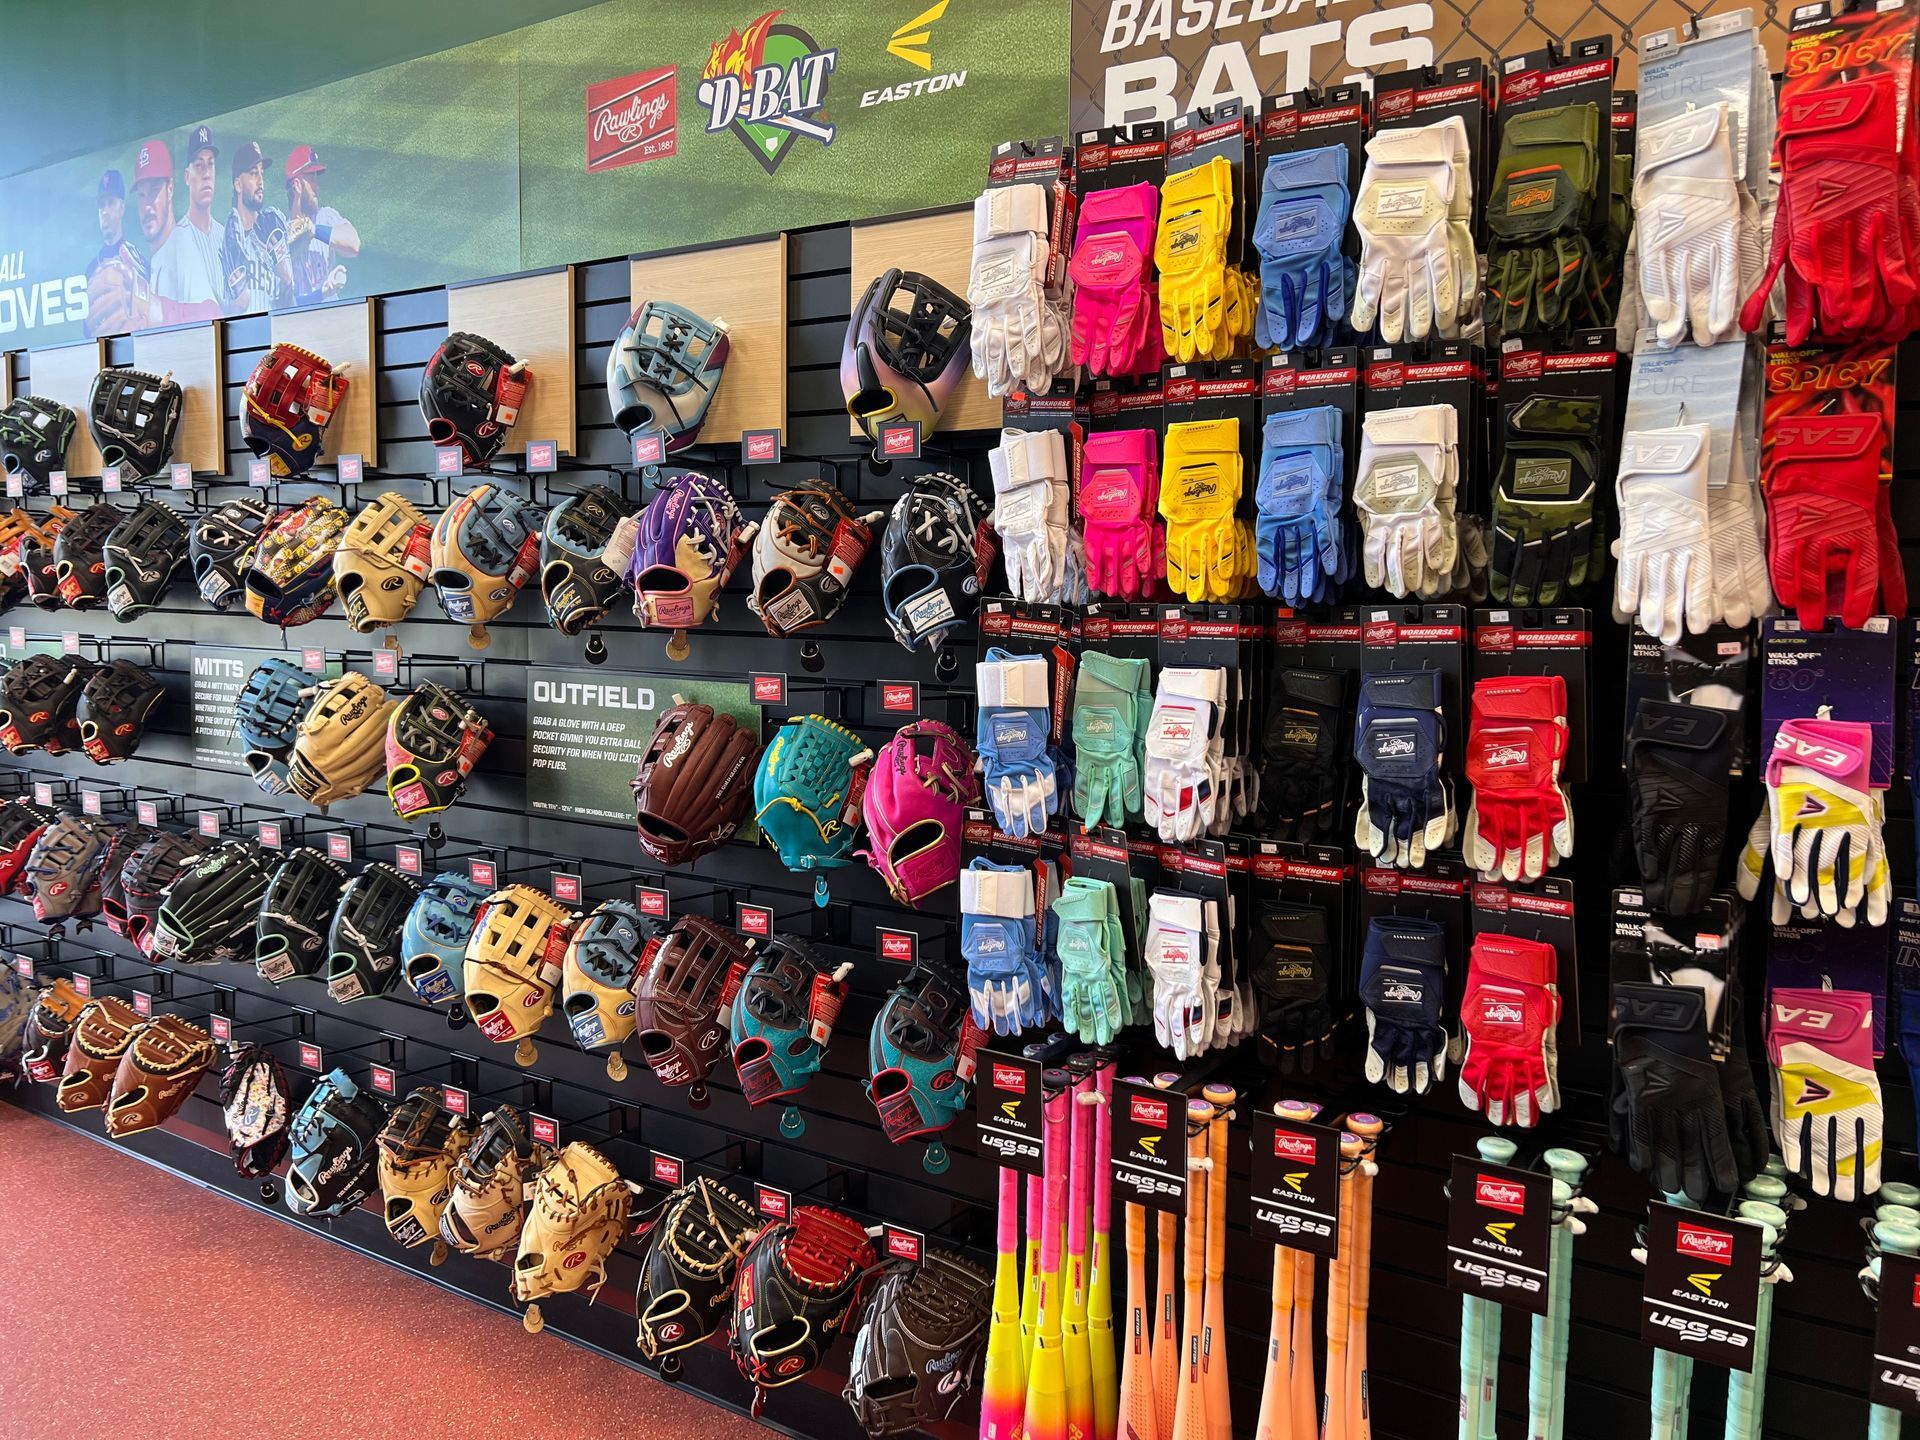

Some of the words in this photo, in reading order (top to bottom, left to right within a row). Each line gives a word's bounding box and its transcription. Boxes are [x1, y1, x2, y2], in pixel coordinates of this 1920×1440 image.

[1100, 0, 1345, 53] BASE
[1788, 33, 1906, 77] SPICY
[1104, 3, 1434, 136] BATS
[1544, 63, 1608, 84] WORKHORSE
[707, 51, 837, 132] D-BAT
[859, 70, 968, 108] EASTON
[1417, 85, 1476, 102] WORKHORSE
[1641, 70, 1716, 104] PURE
[593, 93, 669, 141] Rawlings
[1301, 109, 1356, 122] WORKHORSE
[1196, 122, 1239, 141] WORKHORSE
[643, 143, 657, 156] Est.
[658, 140, 674, 153] 1887
[1111, 145, 1160, 156] WORKHORSE
[1016, 159, 1058, 169] WORKHORSE
[0, 274, 90, 333] OVES
[1506, 357, 1539, 371] Rawlings
[1546, 355, 1610, 365] WORKHORSE
[1299, 371, 1349, 381] WORKHORSE
[1408, 365, 1465, 375] WORKHORSE
[1769, 359, 1892, 393] SPICY
[1199, 382, 1249, 391] WORKHORSE
[1635, 375, 1707, 396] PURE
[1031, 400, 1071, 408] WORKHORSE
[1519, 466, 1567, 486] Rawlings
[659, 604, 691, 616] Rawlings
[913, 597, 945, 622] Rawlings
[1012, 622, 1057, 631] WORKHORSE
[195, 658, 243, 678] MITTS
[534, 681, 655, 710] OUTFIELD
[340, 696, 368, 726] Rawlings
[533, 716, 552, 726] GRAB
[552, 718, 559, 726] A
[559, 718, 581, 729] GLOVE
[581, 720, 599, 730] WITH
[600, 722, 606, 731] A
[607, 723, 625, 733] DEEP
[533, 730, 559, 741] POCKET
[560, 733, 583, 743] GIVING
[585, 735, 600, 745] YOU
[600, 737, 622, 747] EXTRA
[623, 739, 641, 749] BALL
[663, 721, 694, 768] Rawlings
[1378, 738, 1415, 755] Rawlings
[533, 745, 566, 756] SECURITY
[566, 747, 580, 757] FOR
[581, 750, 601, 760] WHEN
[604, 752, 618, 762] YOU
[1487, 748, 1527, 765] Rawlings
[533, 758, 547, 768] POP
[547, 760, 567, 770] FLIES.
[993, 832, 1037, 845] WORKHORSE
[1092, 845, 1125, 857] WORKHORSE
[196, 854, 229, 879] Rawlings
[1184, 857, 1221, 871] WORKHORSE
[1287, 866, 1337, 877] WORKHORSE
[1402, 879, 1458, 890] WORKHORSE
[1511, 897, 1566, 911] WORKHORSE
[1616, 929, 1643, 937] ETHOS
[1384, 984, 1422, 1001] Rawlings
[1484, 1005, 1522, 1022] Rawlings
[996, 1071, 1023, 1083] Rawlings
[1134, 1103, 1165, 1117] Rawlings
[993, 1115, 1026, 1128] EASTON
[1278, 1137, 1313, 1152] Rawlings
[318, 1145, 353, 1185] Rawlings
[1130, 1151, 1167, 1166] EASTON
[1272, 1188, 1315, 1203] EASTON
[1480, 1184, 1521, 1201] Rawlings
[1472, 1237, 1522, 1257] EASTON
[1681, 1234, 1728, 1250] Rawlings
[1672, 1289, 1729, 1309] EASTON
